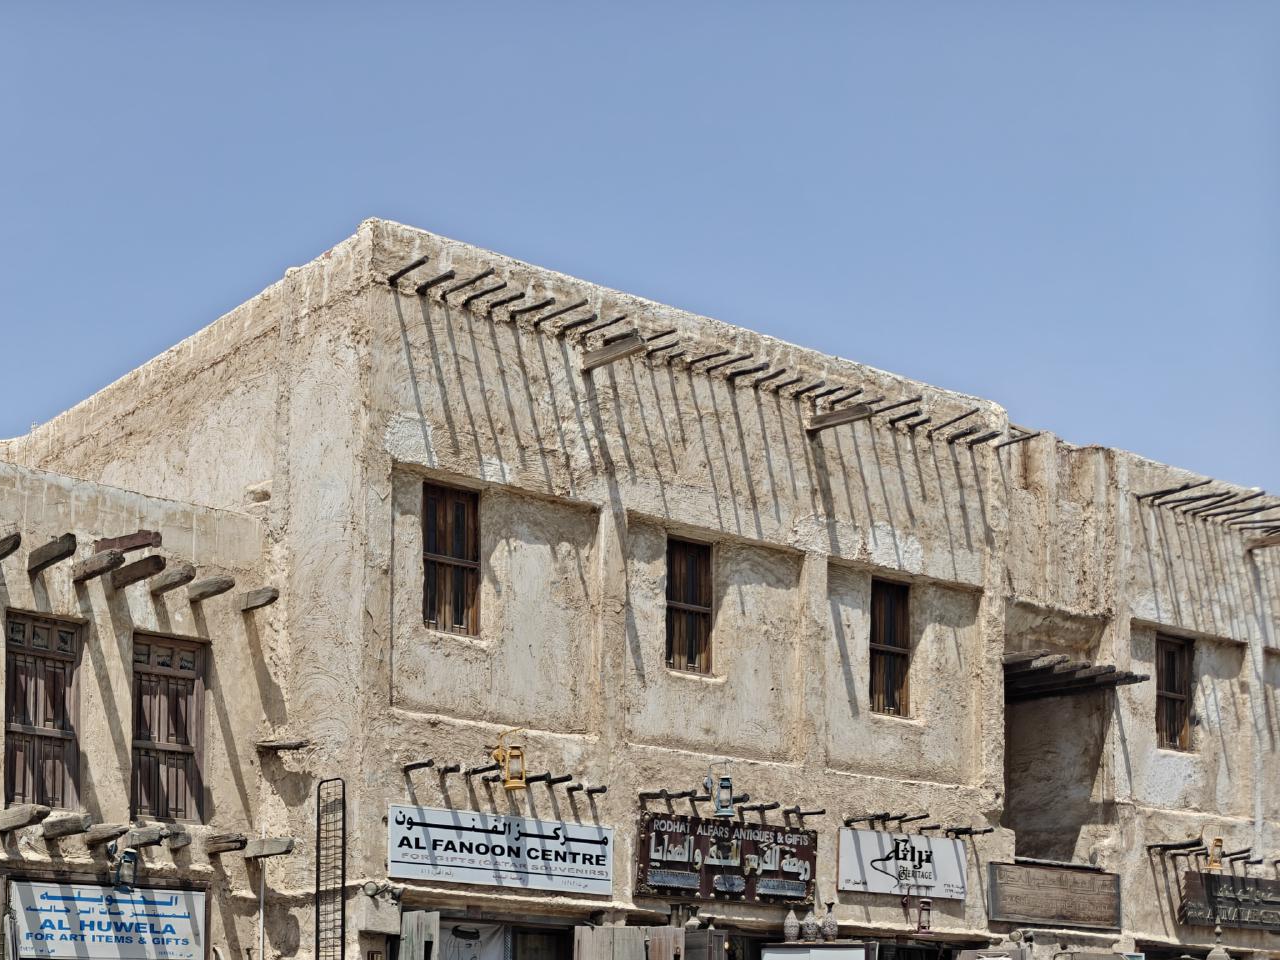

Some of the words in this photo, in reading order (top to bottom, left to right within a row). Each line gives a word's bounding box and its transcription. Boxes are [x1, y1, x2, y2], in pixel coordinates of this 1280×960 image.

[394, 809, 511, 841] الفنون
[514, 821, 609, 847] مركز
[653, 818, 690, 834] RODHAT
[696, 825, 730, 839] ALFARS
[732, 829, 775, 844] ANTIQUES
[776, 831, 785, 844] &
[785, 833, 809, 847] GIFTS
[398, 836, 427, 850] AL
[432, 839, 521, 859] FANOON
[527, 847, 607, 866] CENTRE
[401, 852, 430, 861] FOR
[437, 854, 475, 865] GIFTS
[479, 858, 528, 870] (QATAR
[531, 864, 609, 878] SOUVENIRS)
[897, 865, 933, 881] HERITAGE
[26, 932, 56, 941] FOR
[60, 933, 87, 942] ART
[92, 934, 134, 944] ITEMS
[138, 936, 147, 945] &
[152, 937, 190, 946] GIFTS
[39, 918, 72, 931] AL
[79, 919, 177, 935] HUWELA
